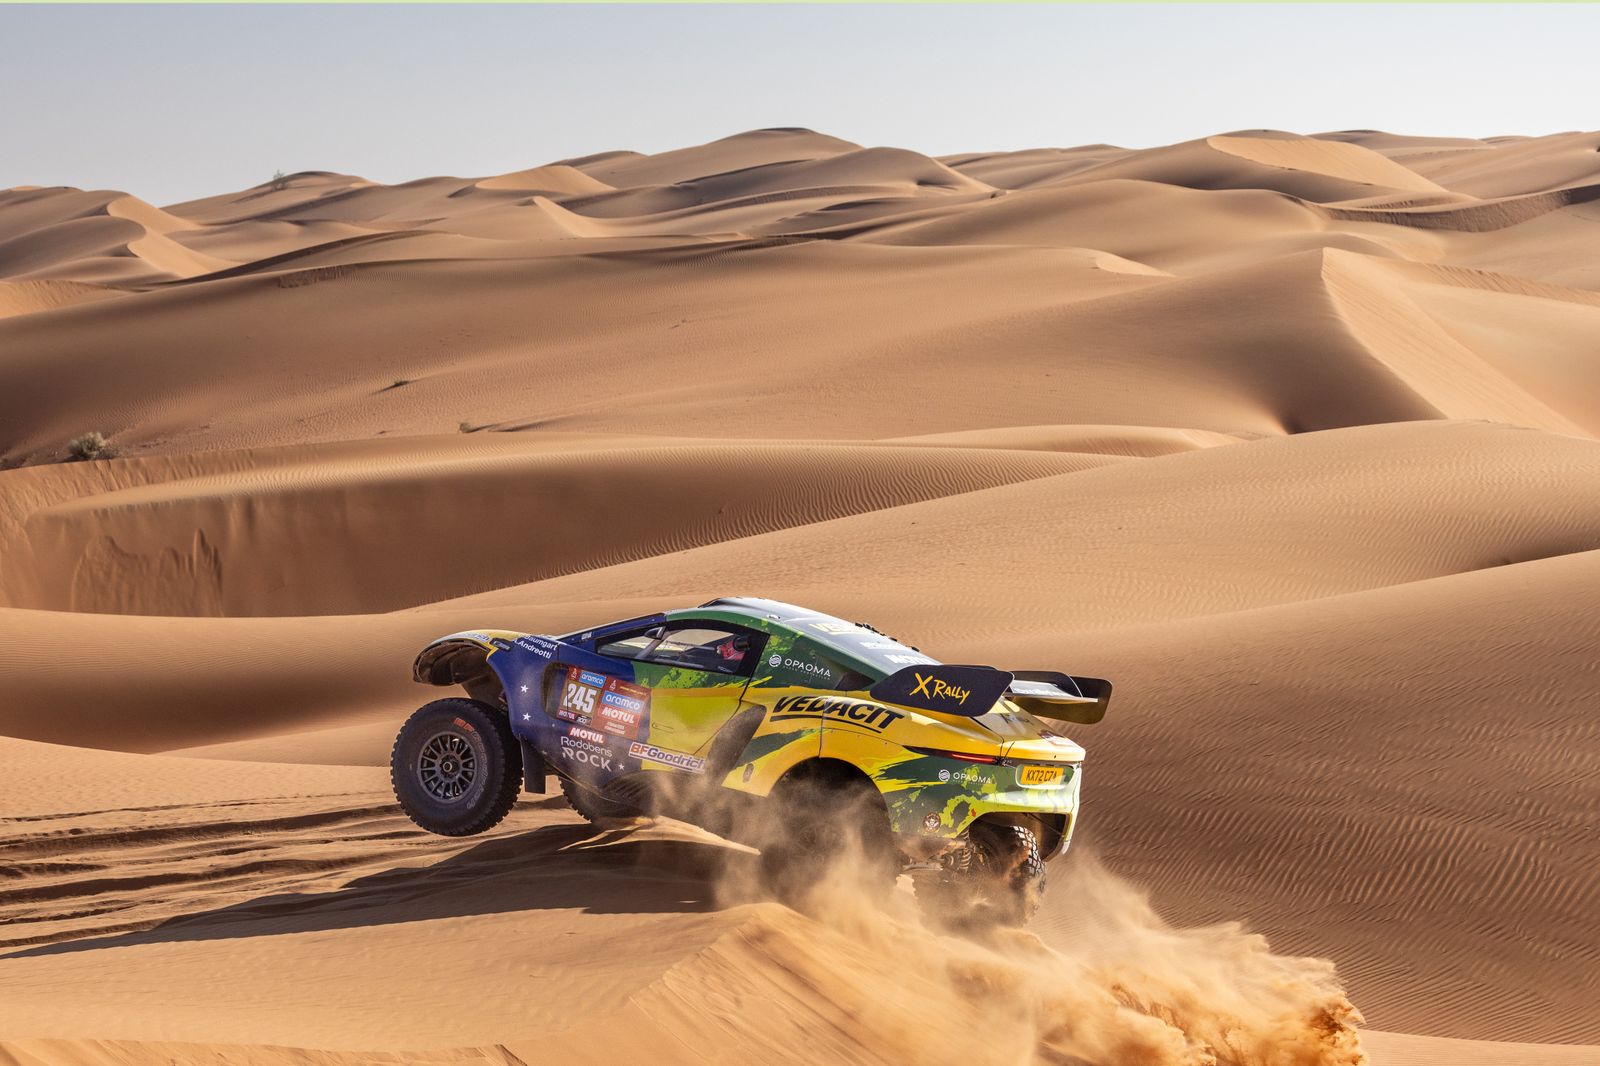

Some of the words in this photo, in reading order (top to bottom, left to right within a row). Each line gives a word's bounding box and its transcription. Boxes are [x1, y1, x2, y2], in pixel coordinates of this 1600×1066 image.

[784, 658, 831, 678] OPAOMA
[581, 673, 604, 685] aramco
[909, 672, 933, 699] X
[933, 679, 970, 705] RALLY
[563, 683, 597, 714] 245
[605, 694, 640, 711] aramco
[558, 709, 576, 720] MOTUL
[602, 706, 635, 724] MOTUL
[772, 695, 904, 730] VEDACIT
[569, 727, 604, 744] MOTUL
[560, 736, 613, 758] Rodobens
[630, 742, 705, 769] BFGoodrich
[562, 746, 612, 772] ROCK
[952, 772, 991, 784] OPAOMA
